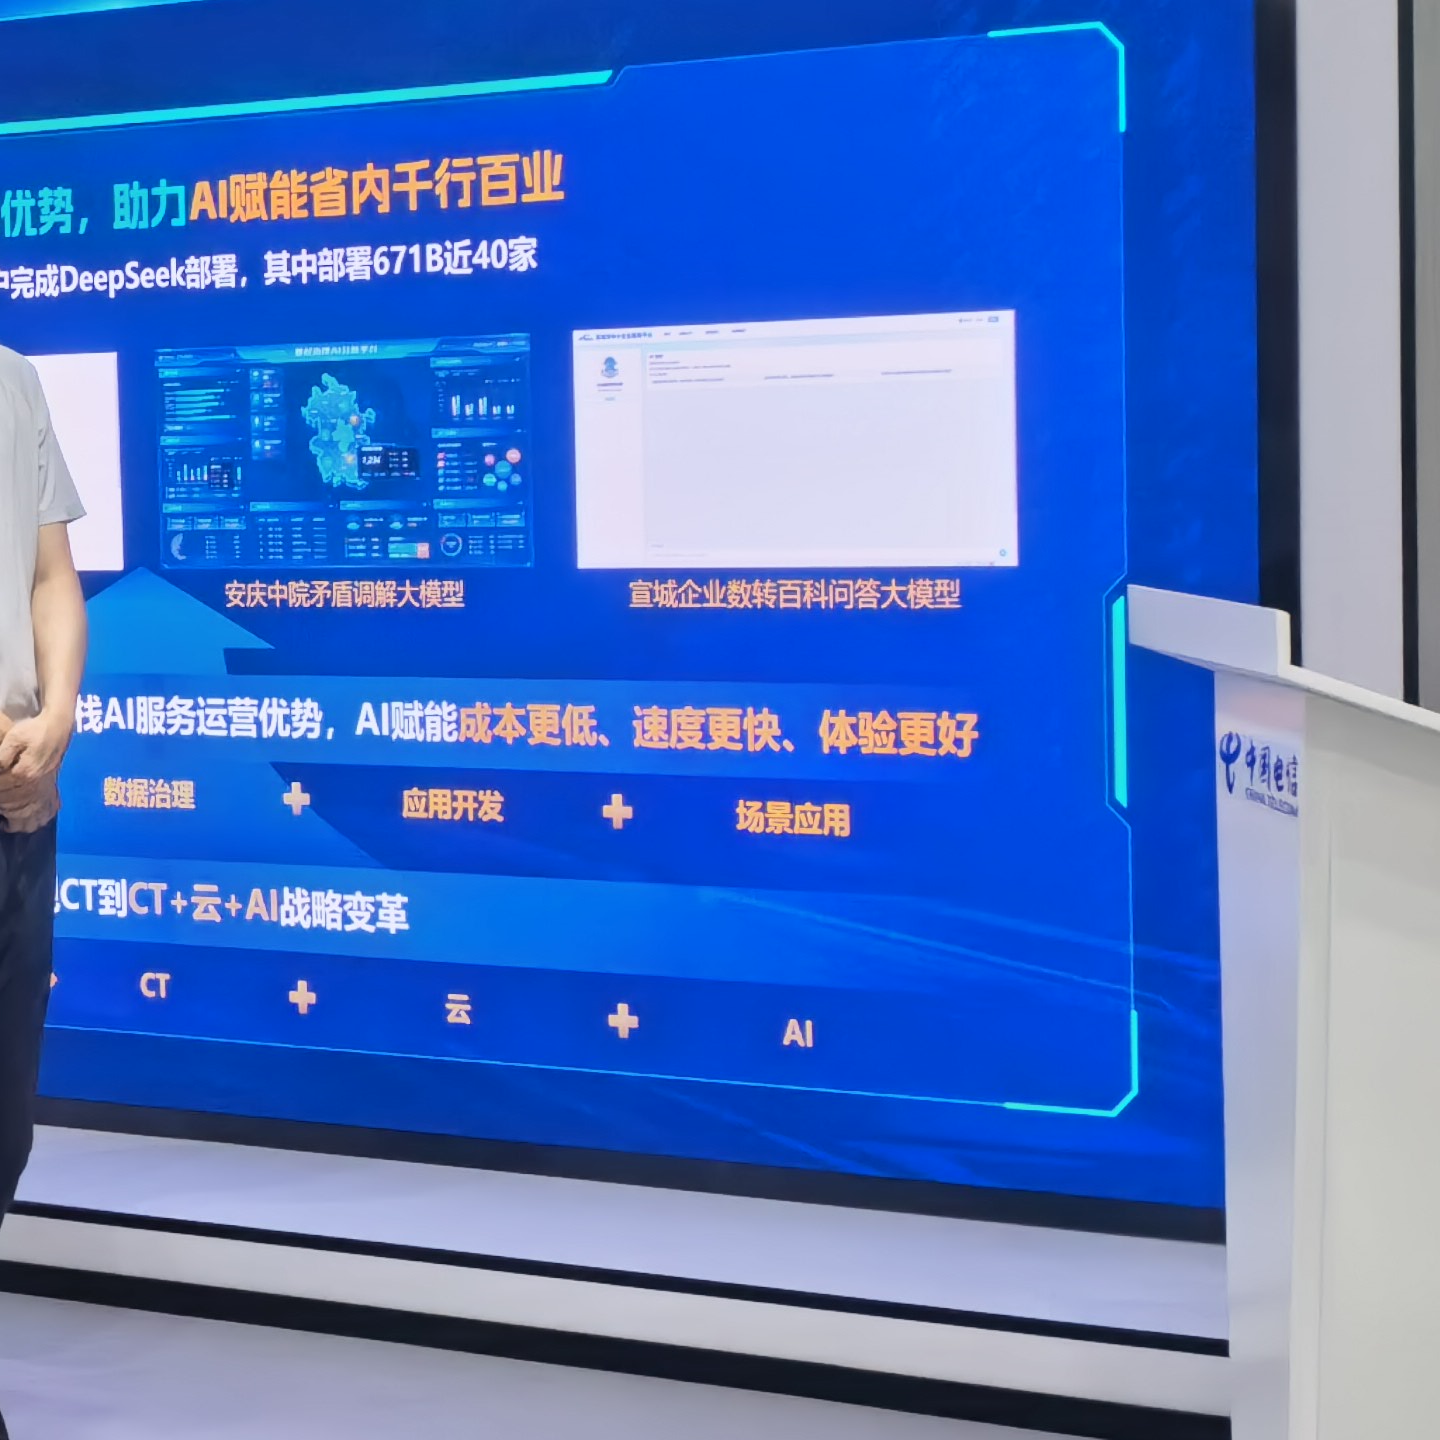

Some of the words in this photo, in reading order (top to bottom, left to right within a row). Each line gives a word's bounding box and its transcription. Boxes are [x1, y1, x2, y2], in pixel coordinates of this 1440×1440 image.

[224, 579, 466, 609] 安庆中院矛盾调解大模型
[628, 578, 963, 610] 宣城企业数转百科问答大模型
[1245, 739, 1299, 797] 中国电信
[103, 776, 197, 810] 数据治理
[401, 787, 506, 823] 应用开发
[735, 799, 852, 838] 场景应用
[139, 971, 171, 999] CT
[444, 993, 473, 1026] 云
[782, 1018, 815, 1048] AI
